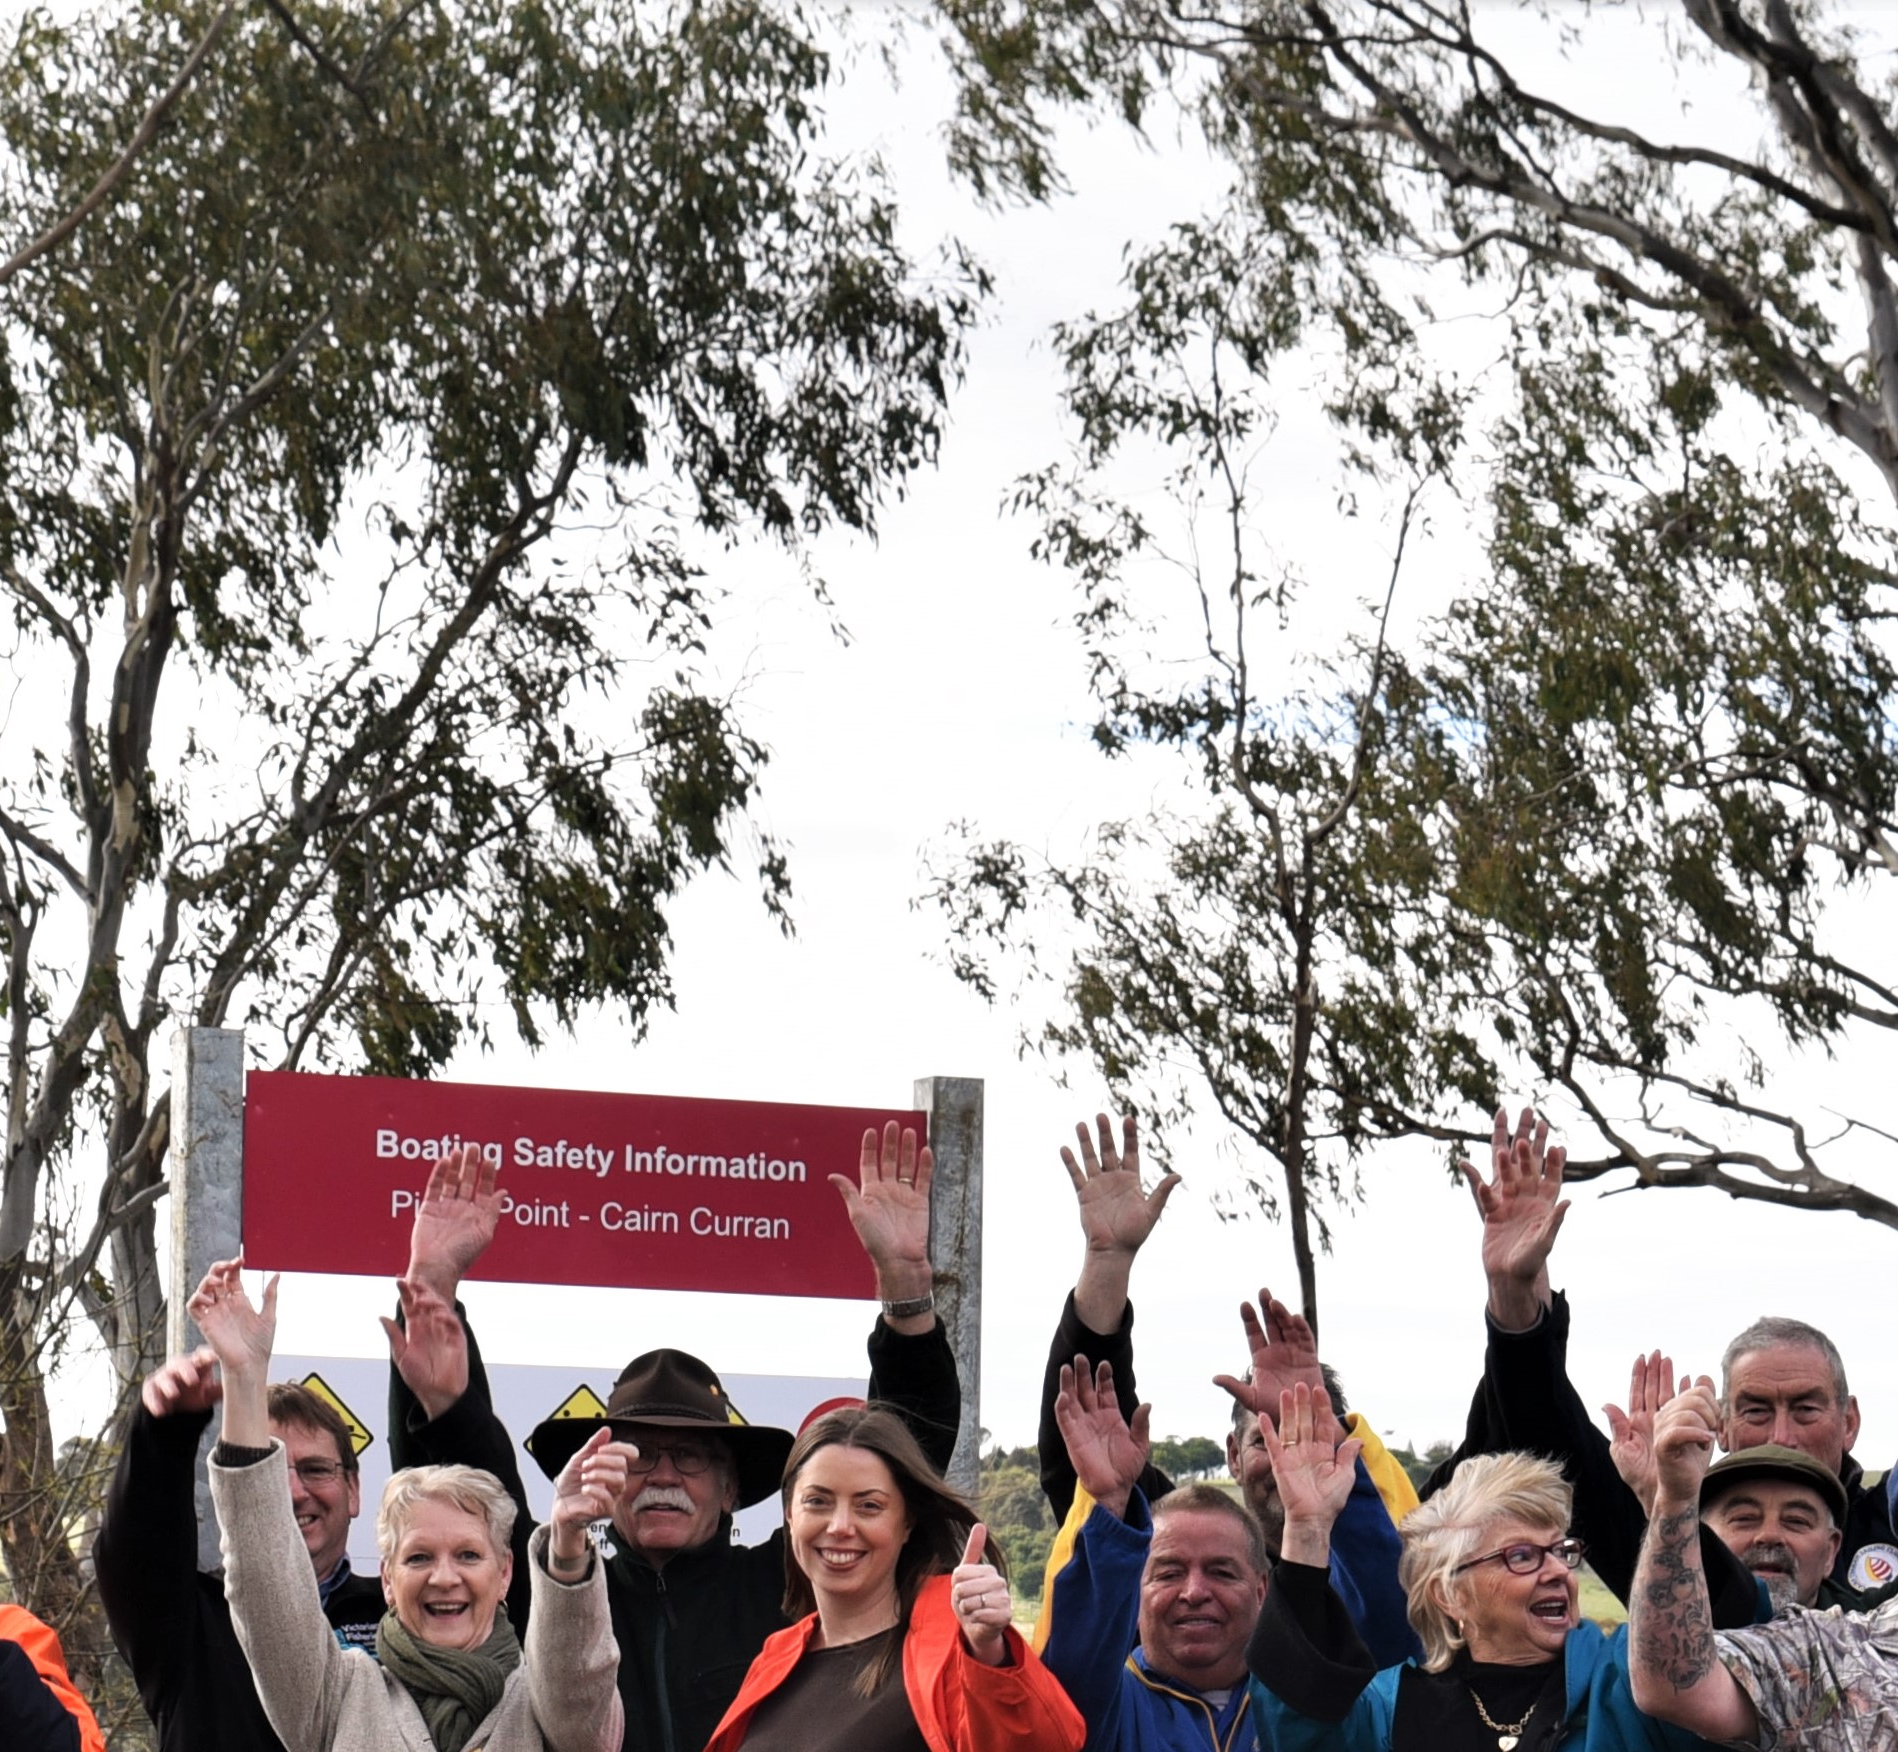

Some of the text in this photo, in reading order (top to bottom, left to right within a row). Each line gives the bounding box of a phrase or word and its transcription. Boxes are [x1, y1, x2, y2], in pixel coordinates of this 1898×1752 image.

[376, 1128, 807, 1183] Boating Safety Information
[599, 1201, 679, 1234] Cairn
[689, 1206, 790, 1240] Curran
